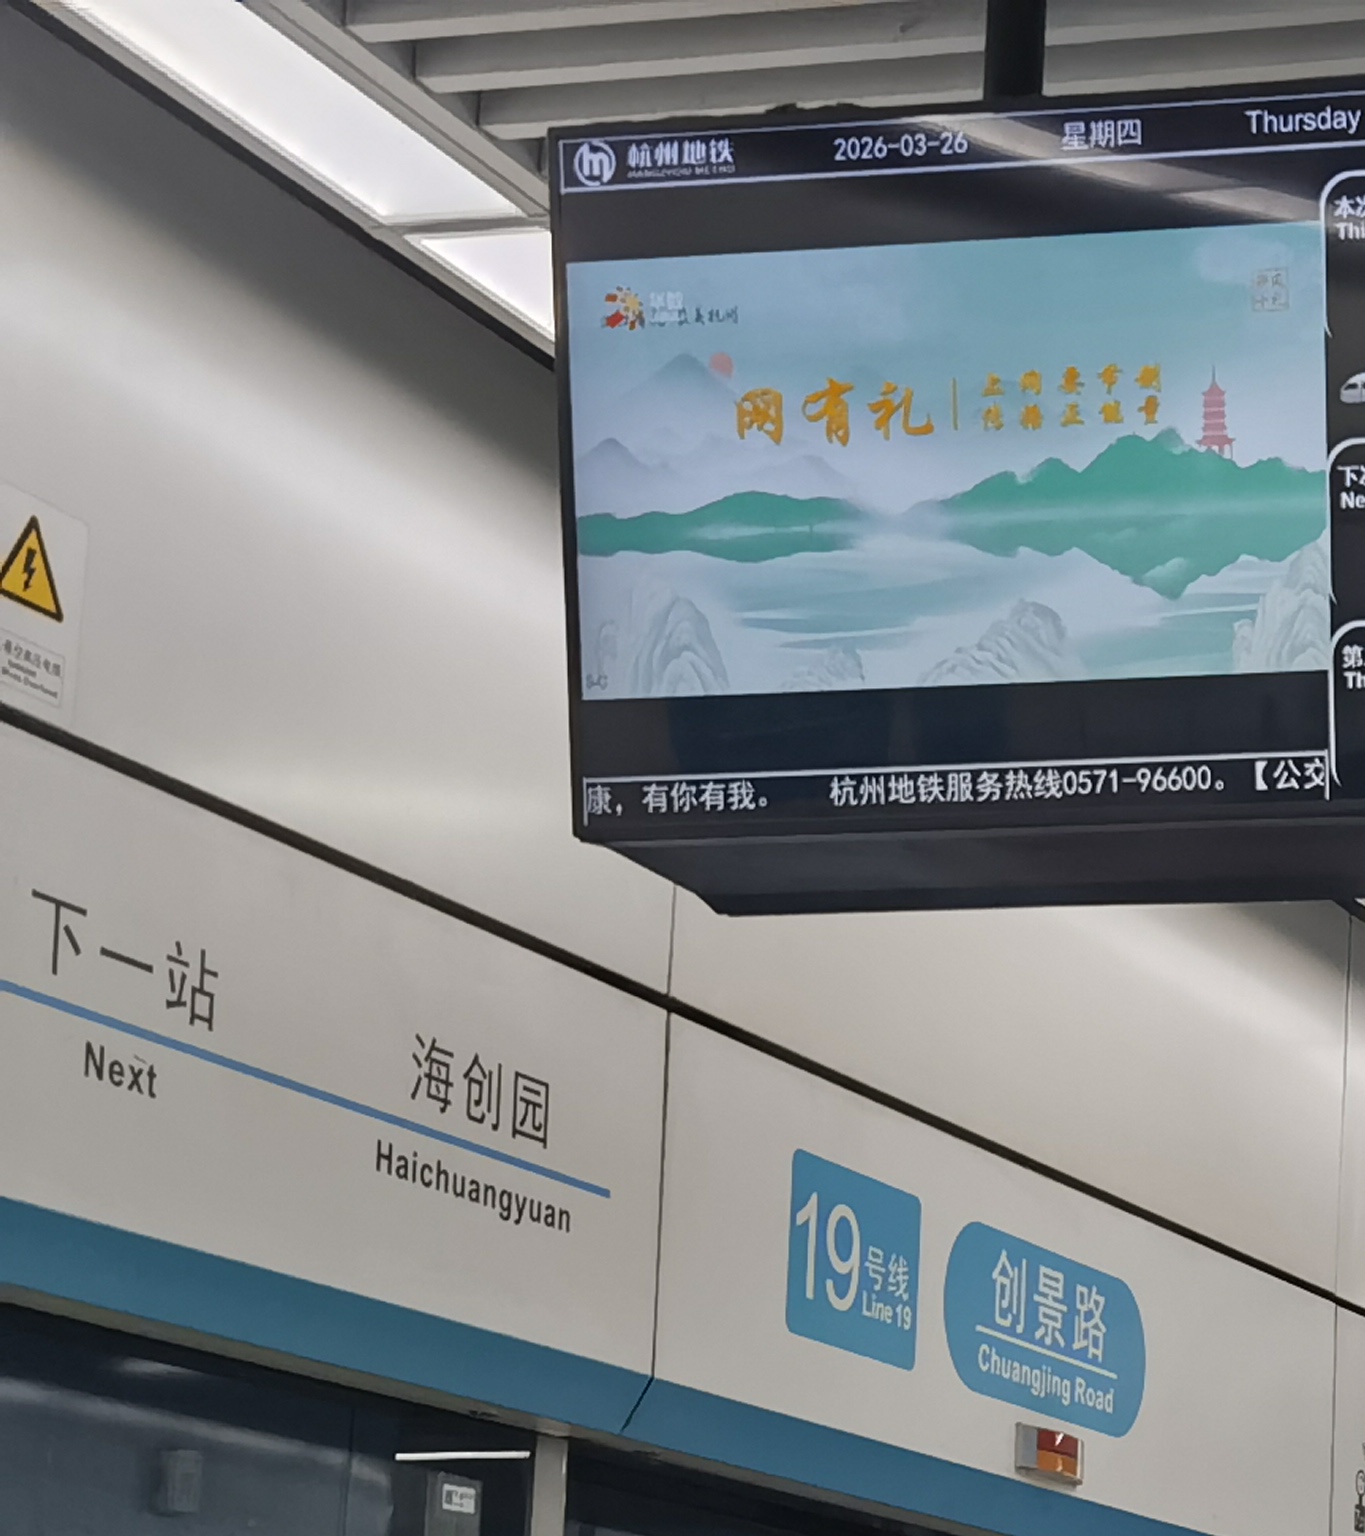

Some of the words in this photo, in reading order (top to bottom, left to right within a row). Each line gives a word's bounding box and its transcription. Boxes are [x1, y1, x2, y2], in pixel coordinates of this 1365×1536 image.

[626, 137, 734, 168] 杭州地铁
[833, 131, 969, 163] 2026-03-26
[1060, 118, 1144, 151] 星期四
[1244, 104, 1362, 137] Thursday
[736, 377, 936, 447] 网有礼
[32, 888, 219, 1032] 下一站
[83, 1040, 157, 1099] Next
[410, 1032, 550, 1149] 海创园
[375, 1138, 572, 1234] Haichuangyuan
[862, 1290, 893, 1325] Line
[895, 1303, 912, 1331] 19
[990, 1247, 1108, 1363] 创景路
[977, 1343, 1071, 1406] Chuangjing
[1075, 1380, 1115, 1415] Road
